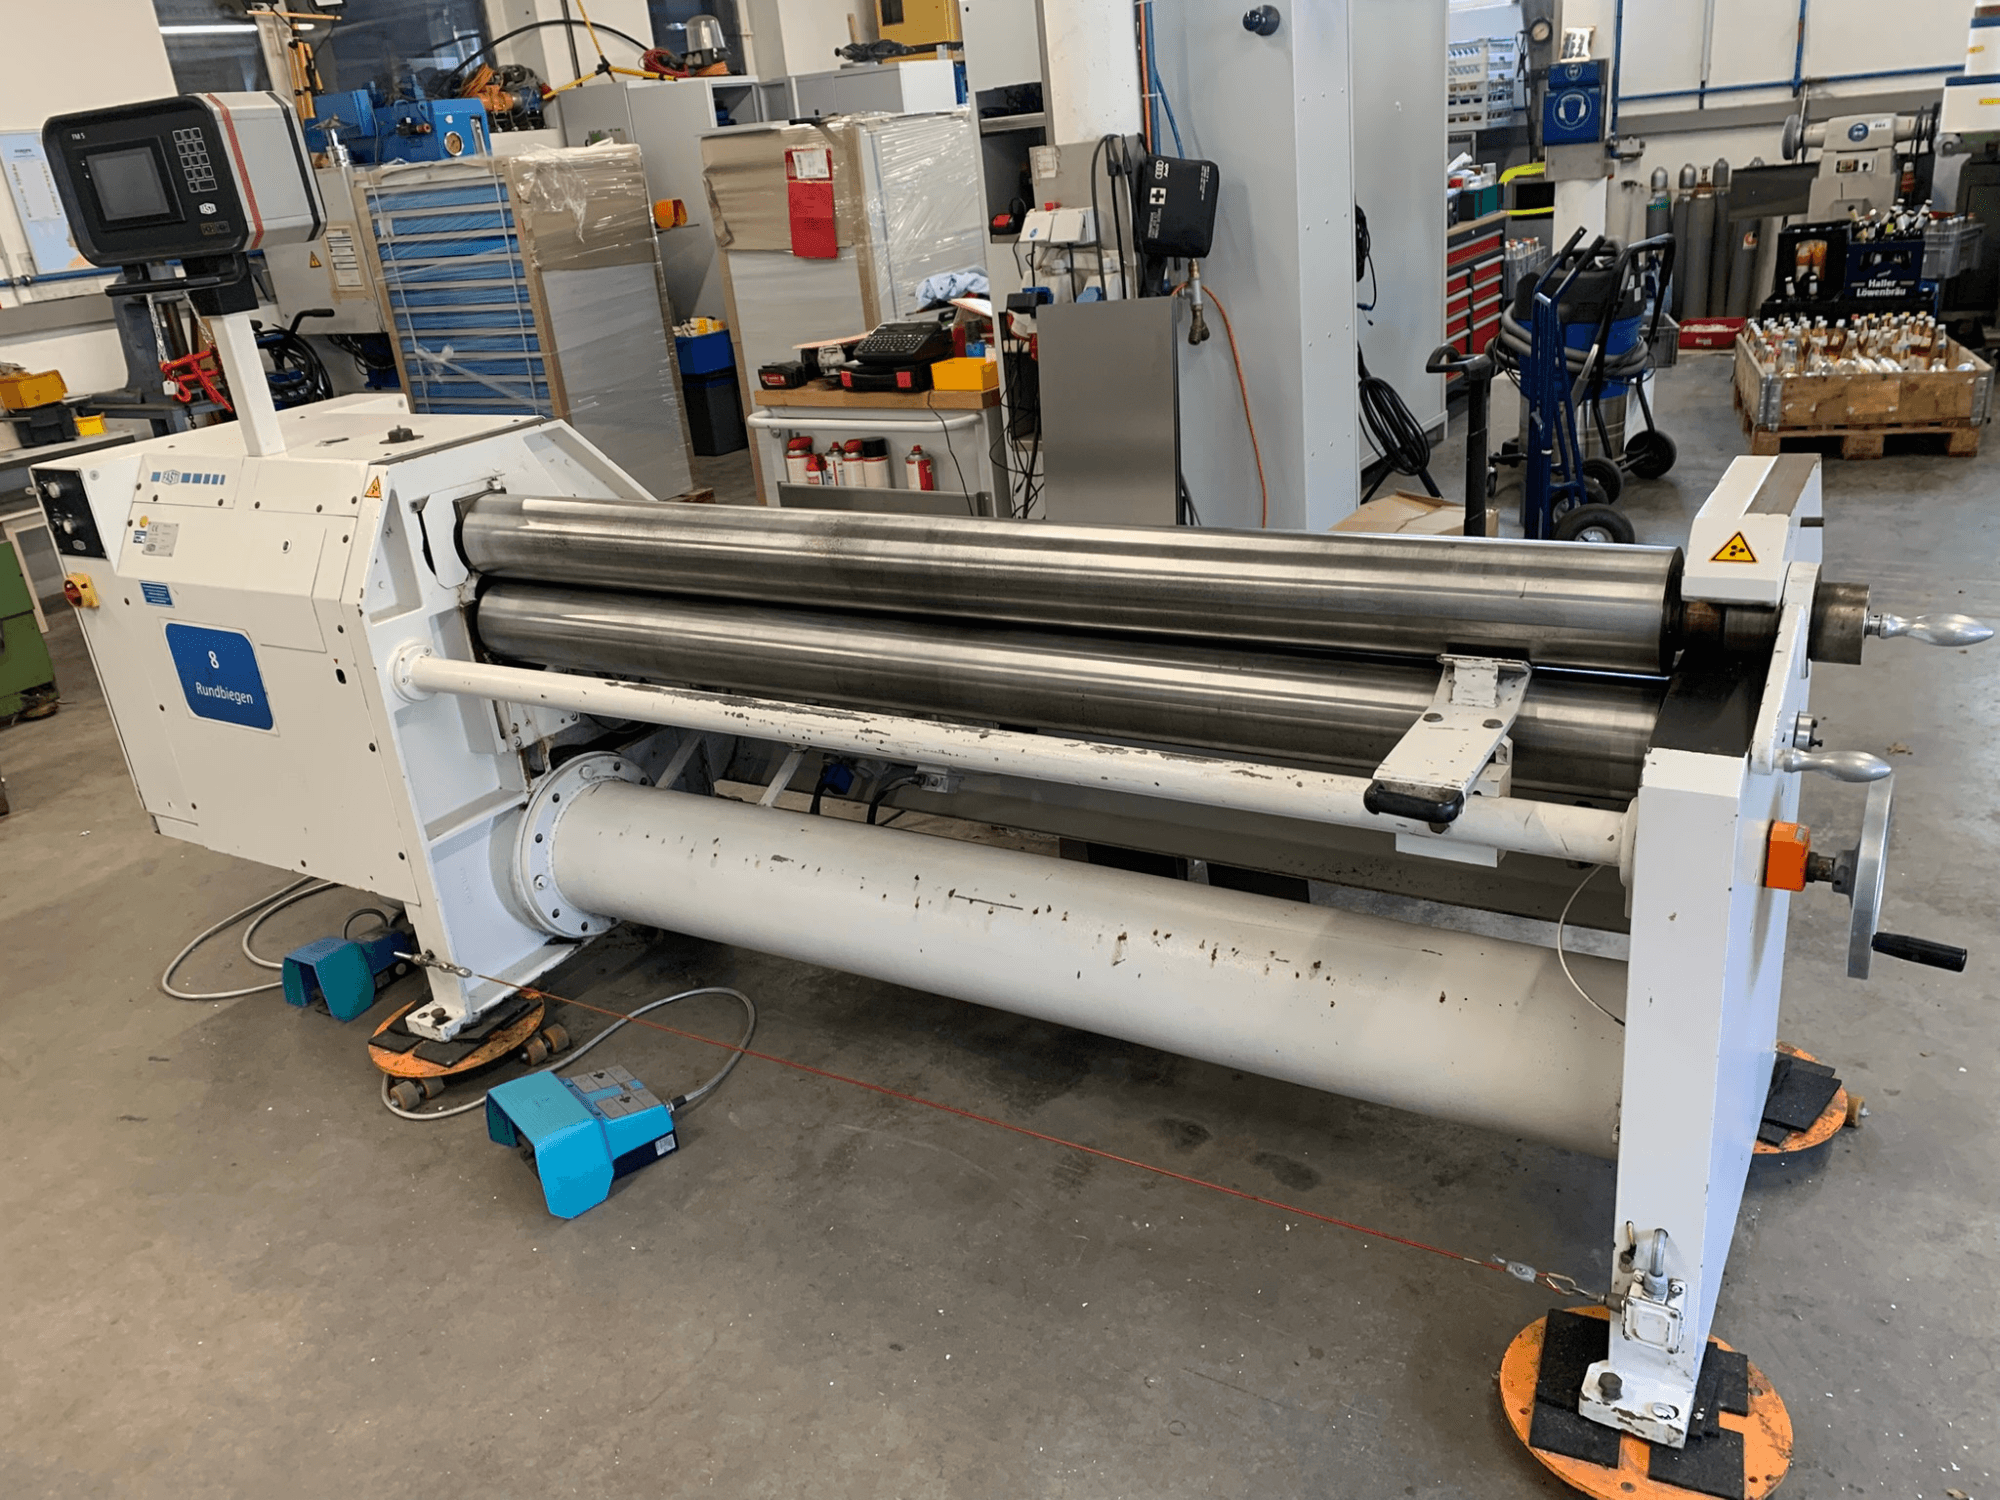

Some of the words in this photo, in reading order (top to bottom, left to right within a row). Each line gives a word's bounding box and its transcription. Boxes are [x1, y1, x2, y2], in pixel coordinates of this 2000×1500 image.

[1868, 279, 1897, 288] Haller
[1856, 287, 1906, 297] Löwenbräu
[208, 650, 220, 669] 8
[195, 681, 253, 705] Rundbiegen
